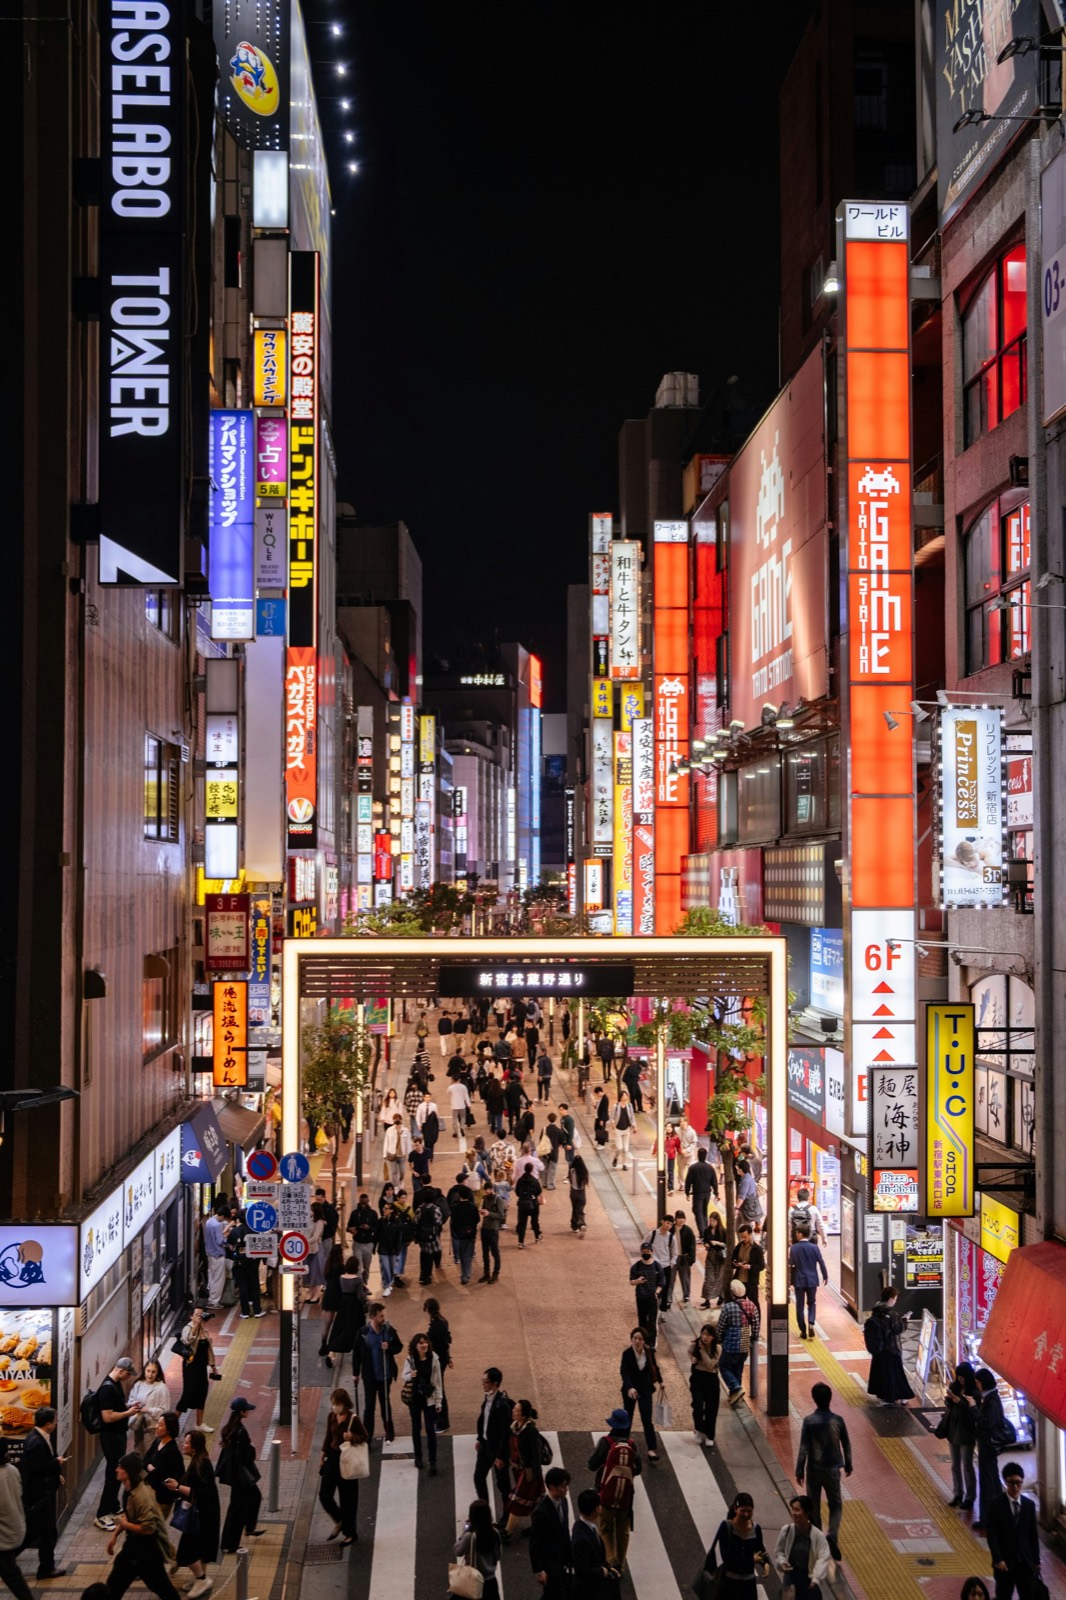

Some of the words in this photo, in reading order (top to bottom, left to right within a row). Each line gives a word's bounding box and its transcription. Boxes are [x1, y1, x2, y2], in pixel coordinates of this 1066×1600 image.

[848, 207, 899, 221] ワールド
[877, 225, 904, 238] ビル
[111, 266, 171, 438] TOWER
[263, 332, 281, 404] タウンハウジング
[291, 312, 314, 419] 驚安の殿堂
[220, 416, 238, 528] アパマンショップ
[258, 444, 283, 479] 占い
[655, 523, 685, 531] ワールド
[670, 532, 687, 541] ビル
[858, 500, 868, 570] TAITO
[615, 555, 632, 647] 和牛と牛タン
[751, 537, 793, 664] GAME
[869, 501, 901, 674] GAME
[858, 577, 869, 674] STATION
[286, 666, 306, 769] ベガスベガス
[985, 723, 998, 785] リフレッシュ
[956, 732, 973, 821] Princess
[597, 797, 609, 827] 大江戸
[968, 780, 978, 819] プリンセス
[985, 790, 998, 825] 新宿店
[864, 943, 902, 972] 6F
[478, 972, 584, 987] 新宿武蔵野通り
[220, 984, 240, 1084] 俺流塩らーめん
[877, 1074, 918, 1099] 麺屋
[876, 1132, 884, 1162] らーめん
[884, 1102, 911, 1163] 海神
[880, 1171, 909, 1184] Pizza
[932, 1139, 944, 1210] 新宿駅東南口店
[945, 1151, 957, 1198] SHOP
[252, 1209, 266, 1229] P
[261, 1220, 271, 1229] 40
[286, 1240, 303, 1254] 30
